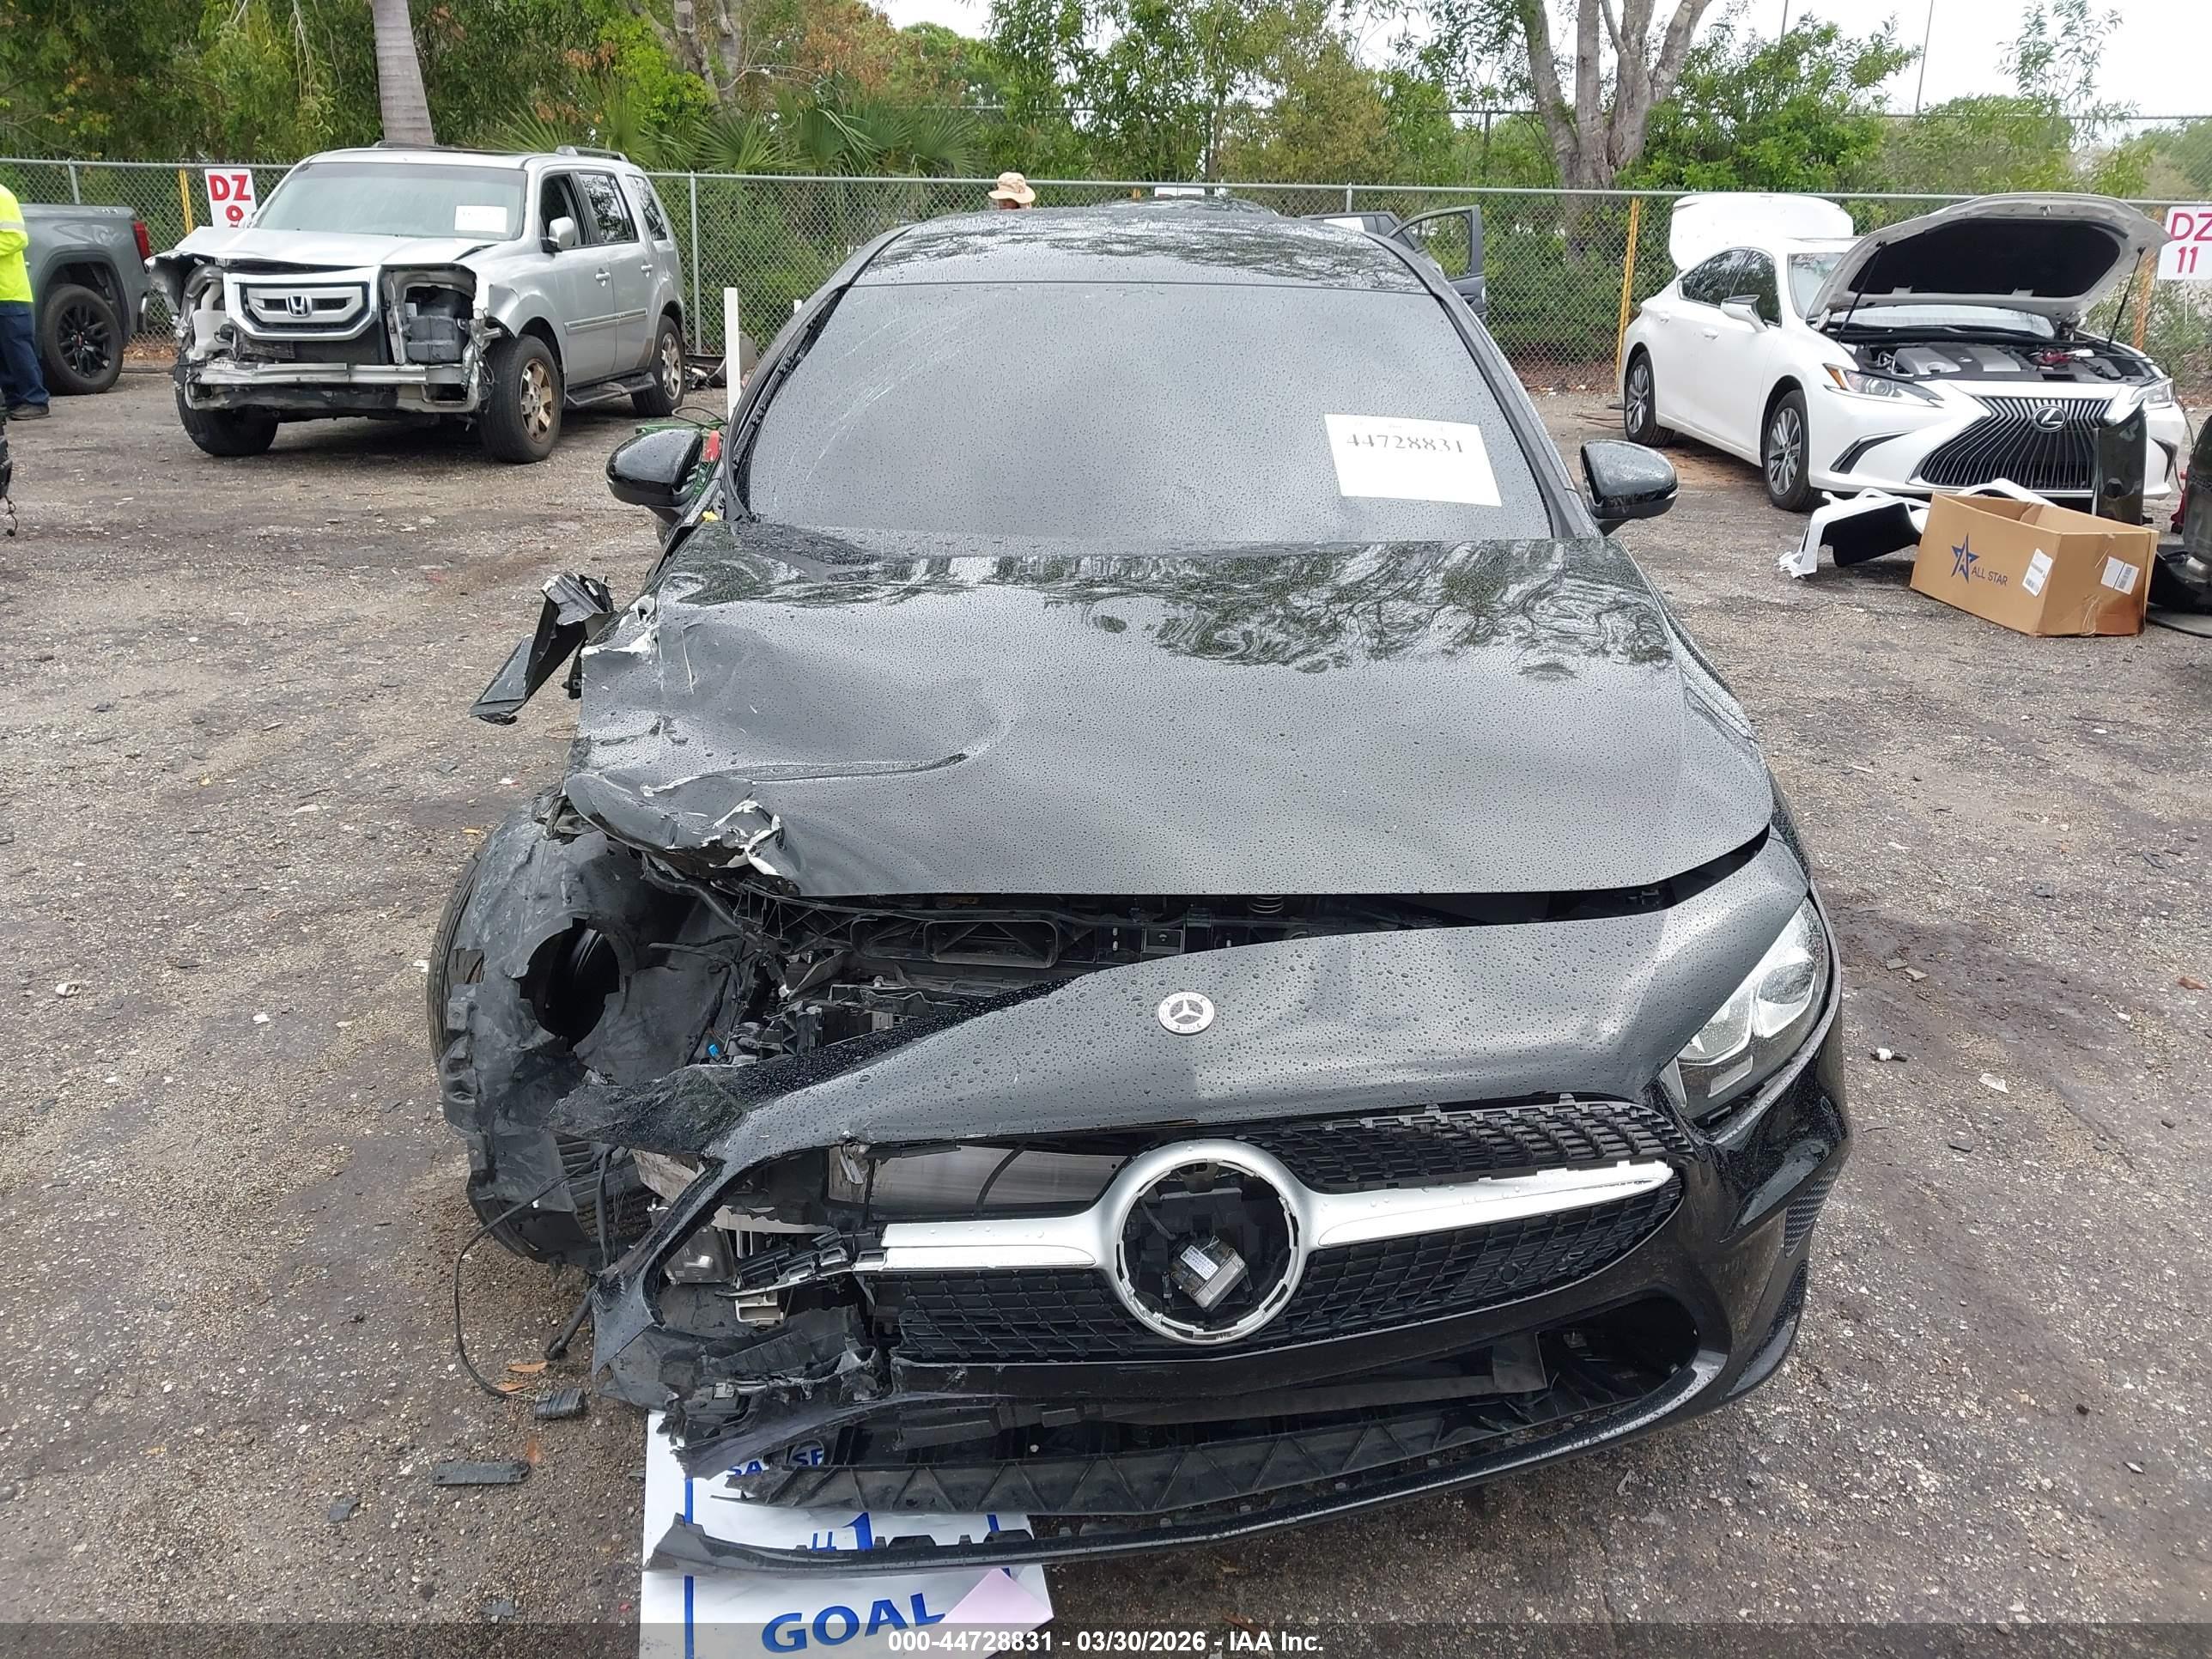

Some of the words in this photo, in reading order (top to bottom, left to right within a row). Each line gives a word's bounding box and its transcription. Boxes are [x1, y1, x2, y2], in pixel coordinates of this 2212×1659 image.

[208, 174, 252, 201] DZ
[225, 204, 244, 228] 9
[2170, 212, 2212, 241] DZ
[2177, 246, 2198, 273] 11
[1346, 433, 1463, 453] 44728831
[1971, 565, 1986, 580] ALL
[1987, 570, 2008, 586] STAR
[761, 1592, 946, 1654] GOAL
